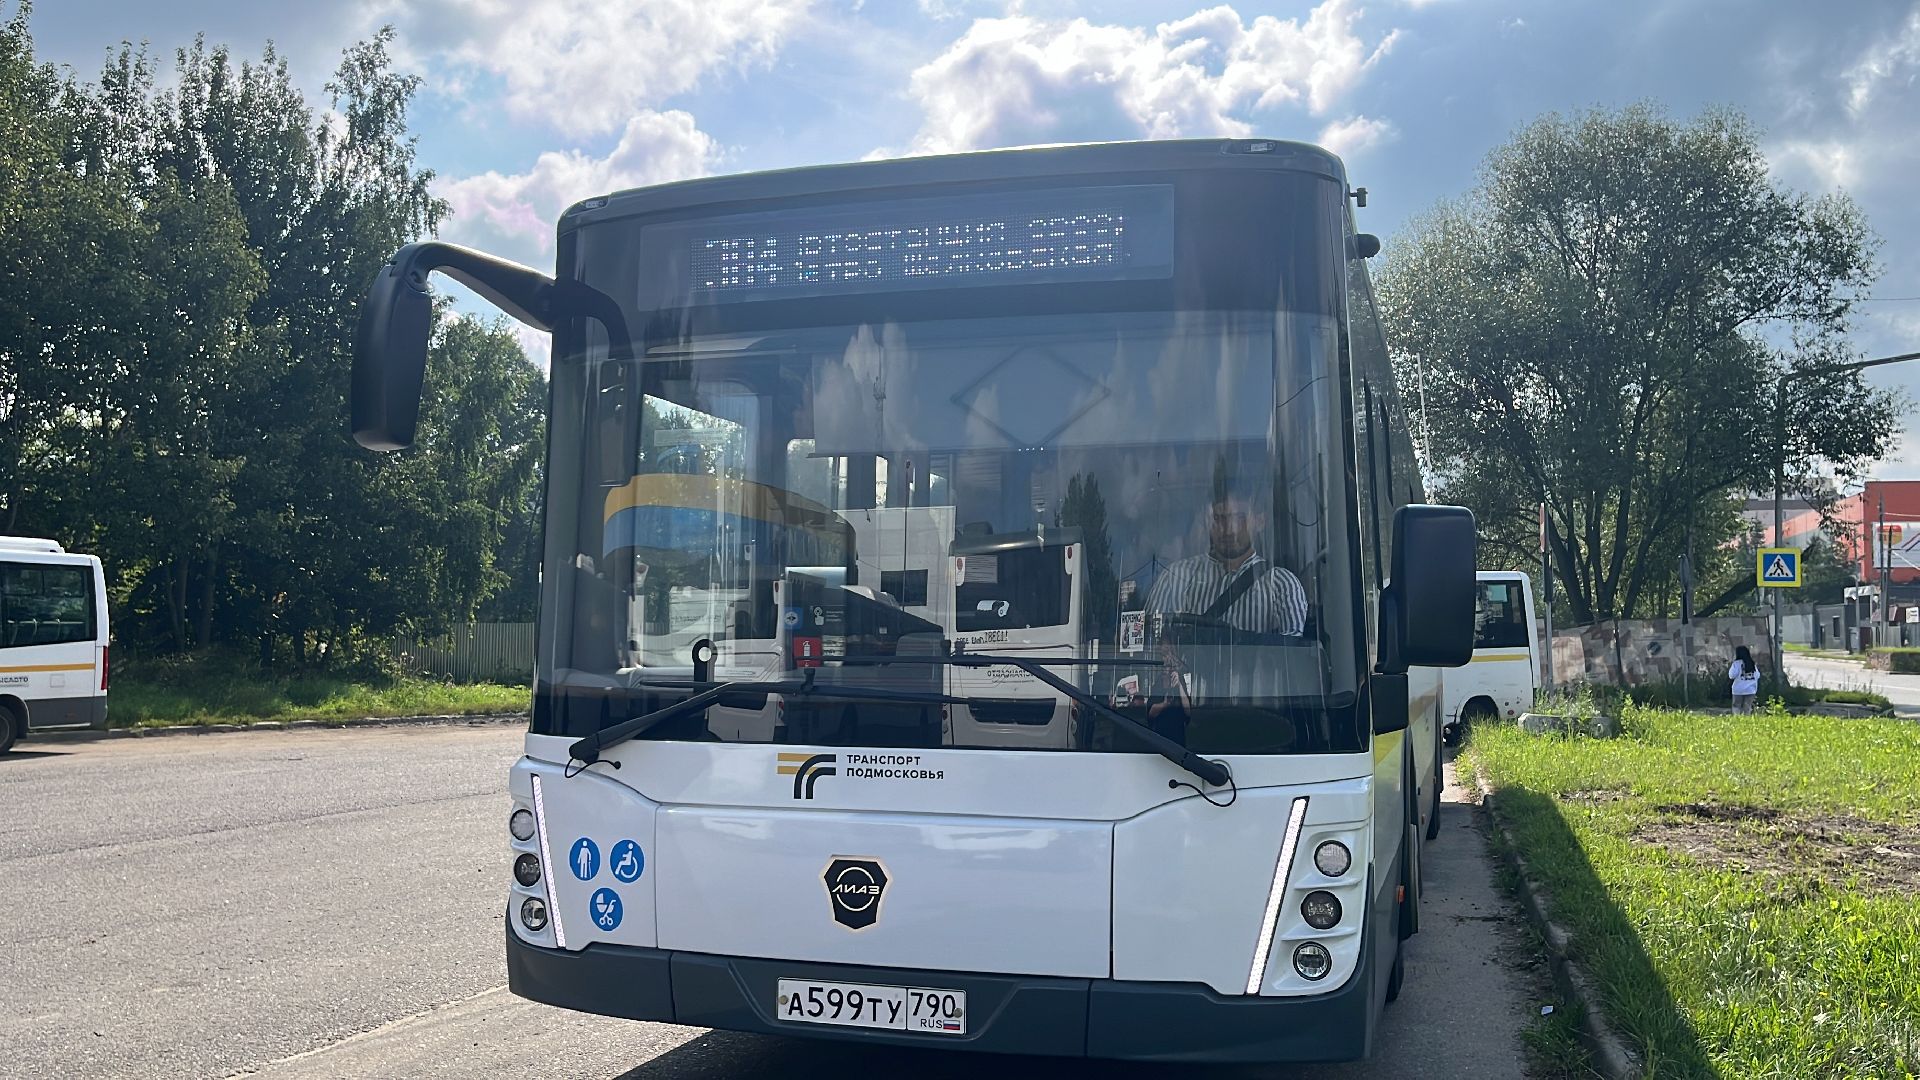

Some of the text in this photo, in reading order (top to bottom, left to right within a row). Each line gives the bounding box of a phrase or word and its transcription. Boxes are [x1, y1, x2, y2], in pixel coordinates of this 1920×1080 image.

[846, 754, 921, 766] ТРАНСПОРТ
[846, 767, 944, 780] ПОДМОСКОВЬЯ
[831, 883, 880, 895] ЛИАЗ
[788, 986, 957, 1024] А599ТУ 790
[920, 1018, 943, 1029] RUS
